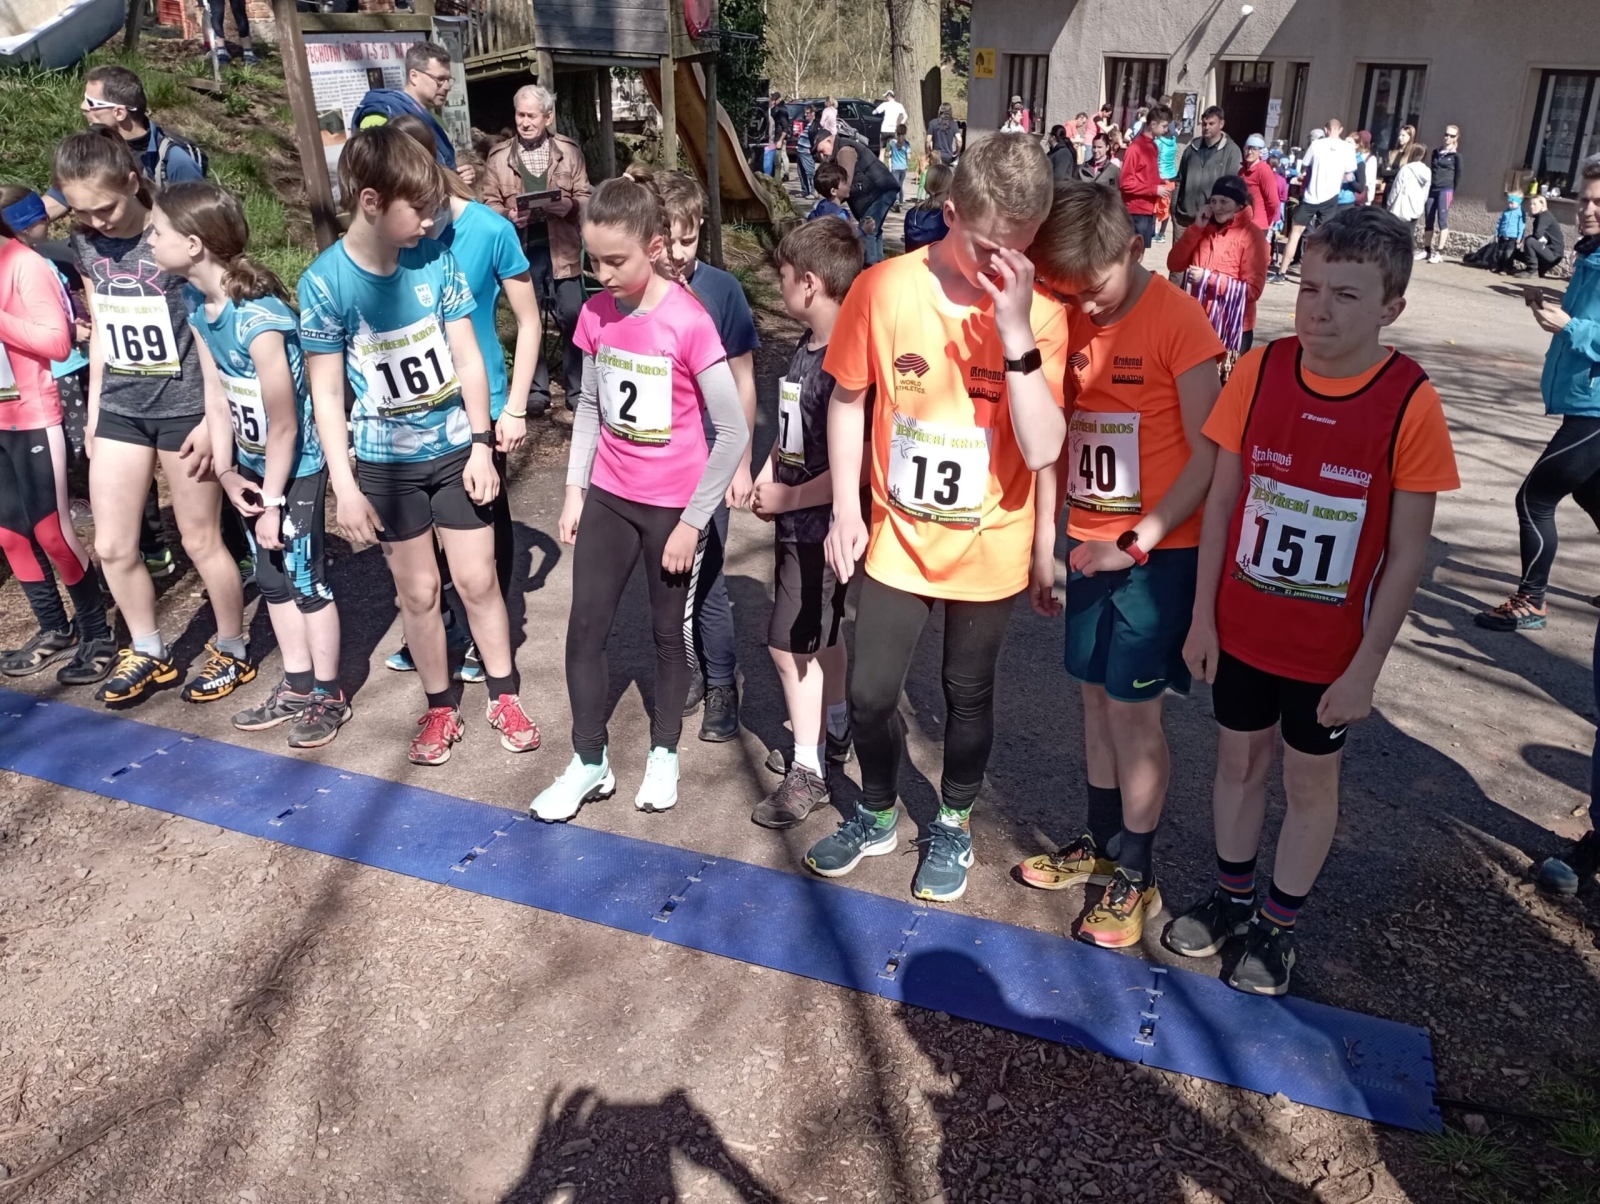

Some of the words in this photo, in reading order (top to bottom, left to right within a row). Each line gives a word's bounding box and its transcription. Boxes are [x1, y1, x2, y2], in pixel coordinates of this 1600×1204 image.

[106, 323, 167, 361] 169
[412, 324, 437, 343] KROS
[376, 348, 446, 399] 161
[636, 363, 668, 377] KROS
[619, 380, 637, 423] 2
[896, 423, 946, 446] JESTŘEBÍ
[950, 437, 987, 449] KROS
[1100, 423, 1134, 434] KROS
[912, 455, 962, 506] 13
[1079, 444, 1117, 492] 40
[1252, 487, 1310, 514] JESTŘEBÍ
[1312, 505, 1358, 522] KROS
[1252, 517, 1337, 582] 151
